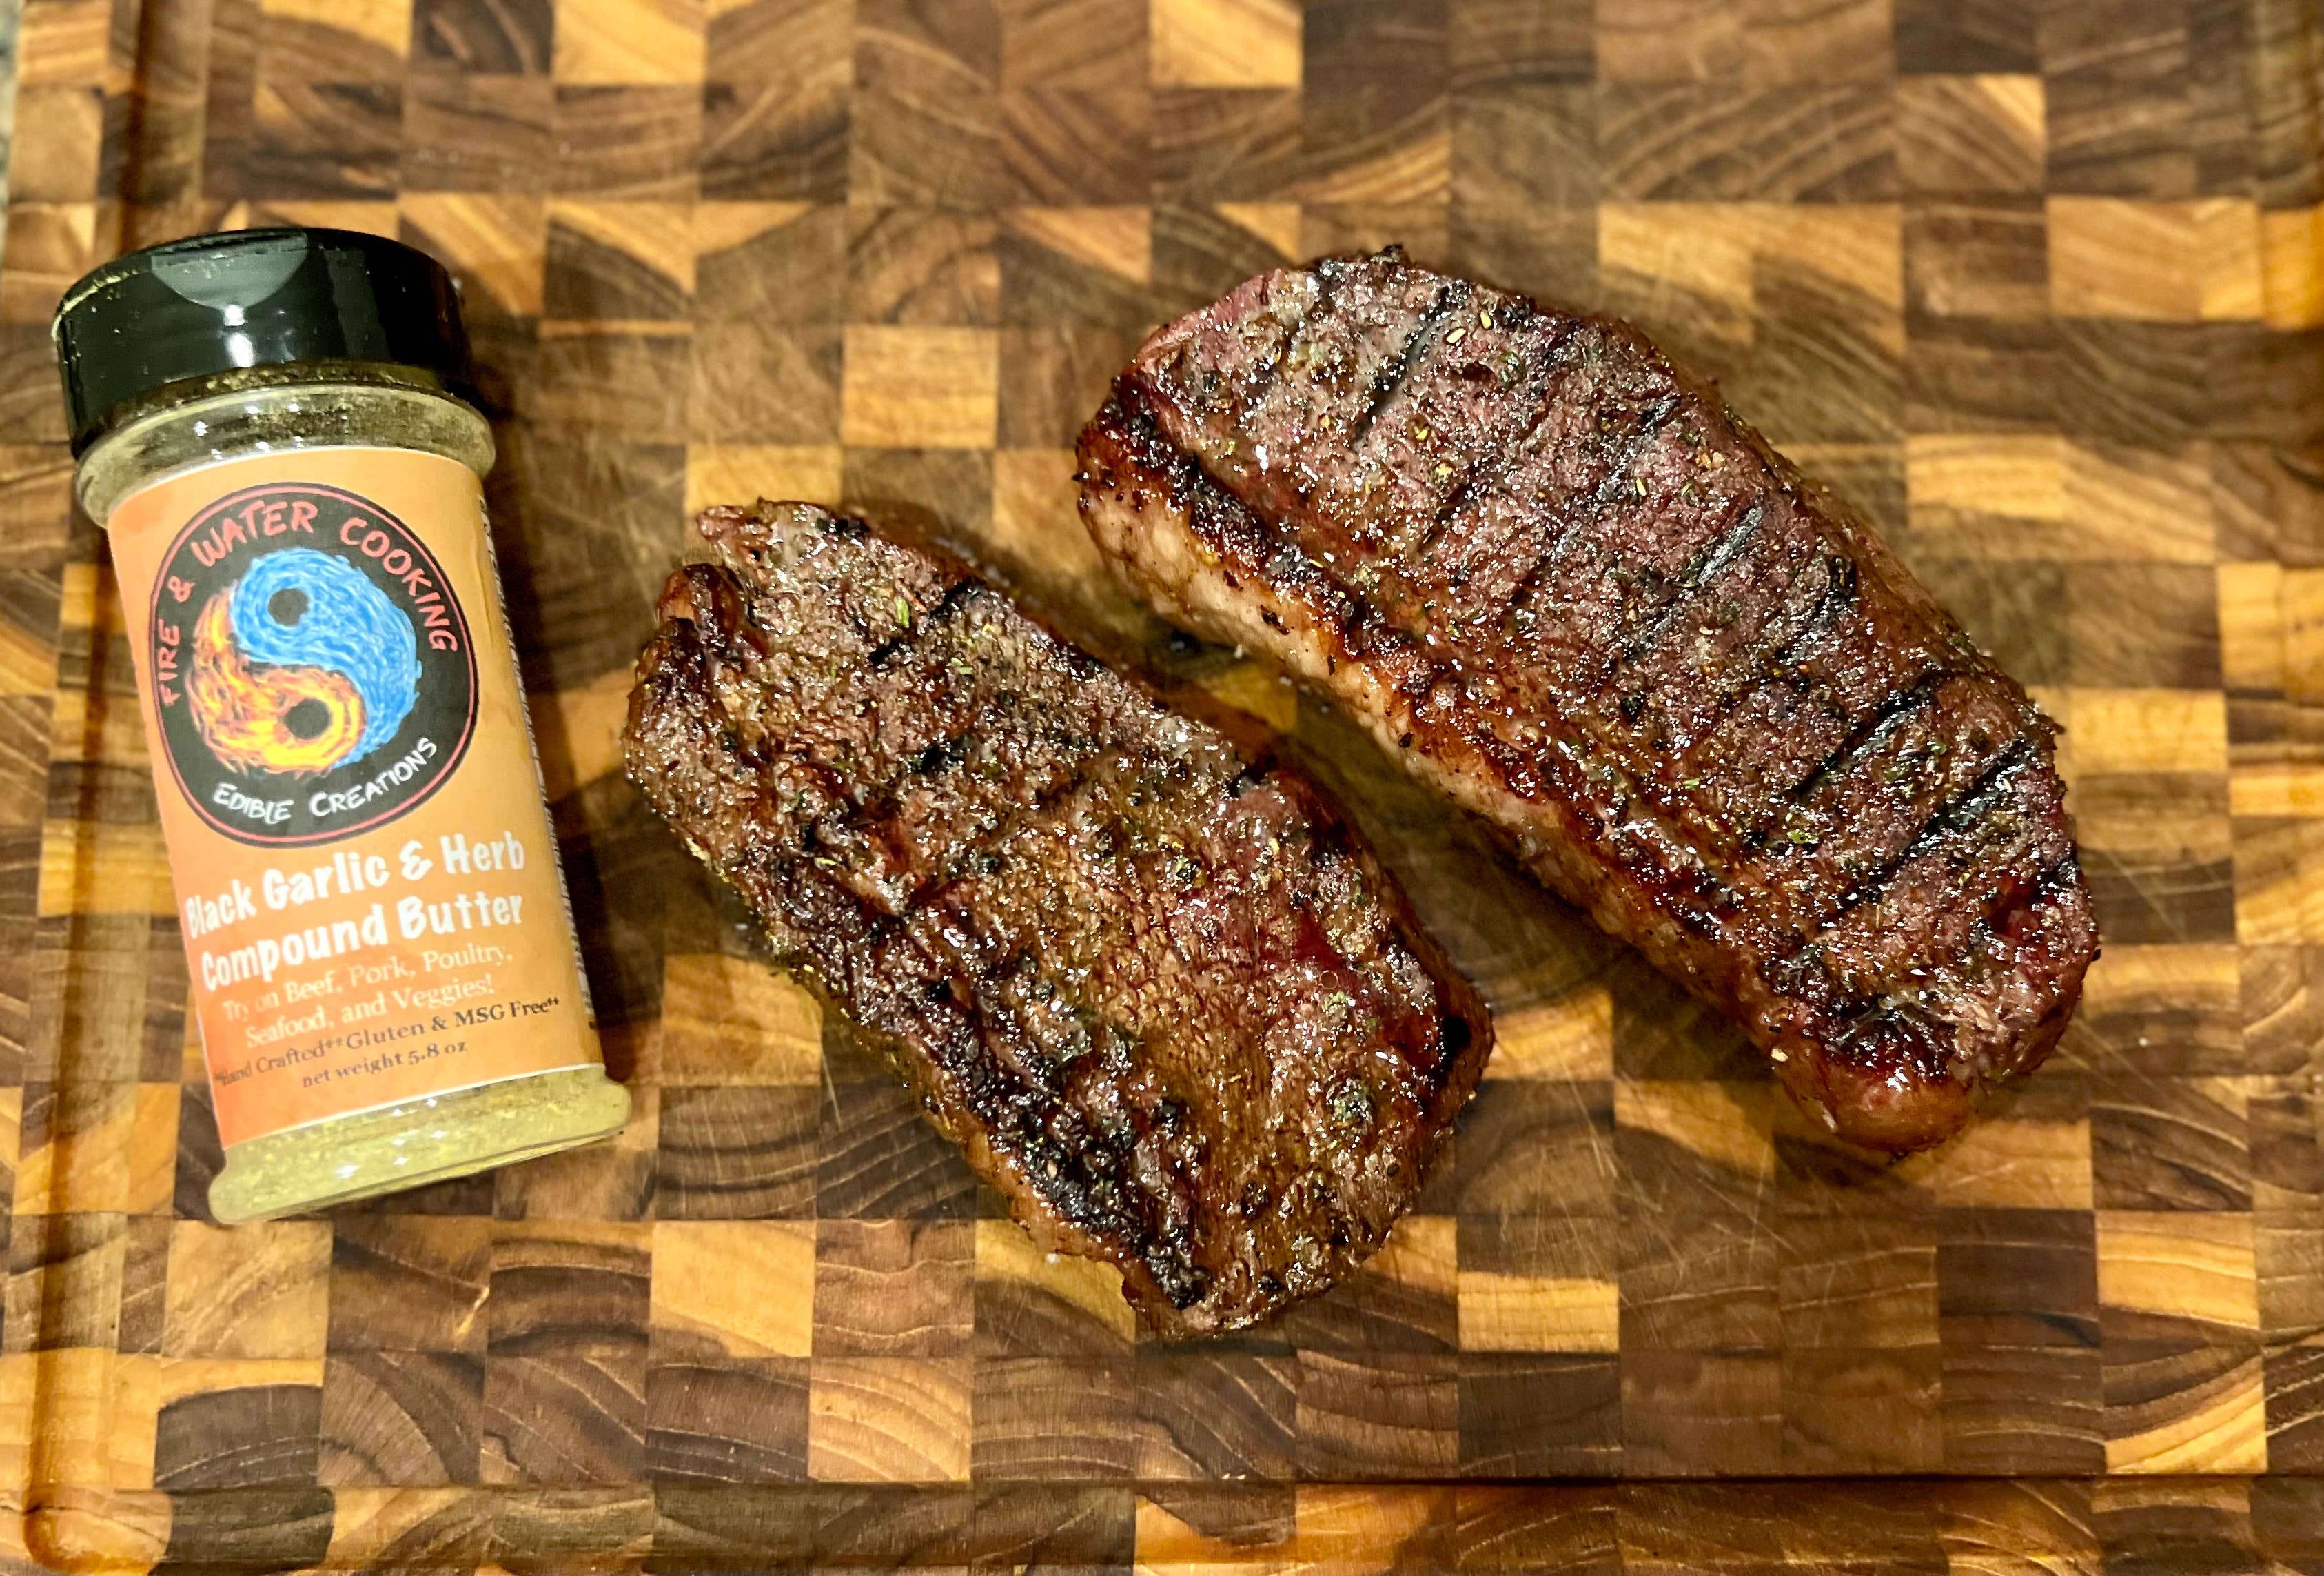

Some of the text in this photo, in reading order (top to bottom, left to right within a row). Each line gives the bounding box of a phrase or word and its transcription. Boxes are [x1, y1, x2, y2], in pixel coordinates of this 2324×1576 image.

[158, 500, 458, 706] FIRE & WATER COOKING
[212, 737, 437, 825] EDIBLE CREATIONS
[185, 830, 524, 939] Black Garlic & Herb
[202, 891, 523, 991] Compound Butter
[222, 942, 513, 1022] Try on Beef, Pork, Poultry,
[246, 973, 495, 1048] Seafood, and Veggies!
[431, 1015, 447, 1032] &
[453, 1004, 505, 1028] MSG
[303, 1040, 468, 1088] net weight 5.8 oz
